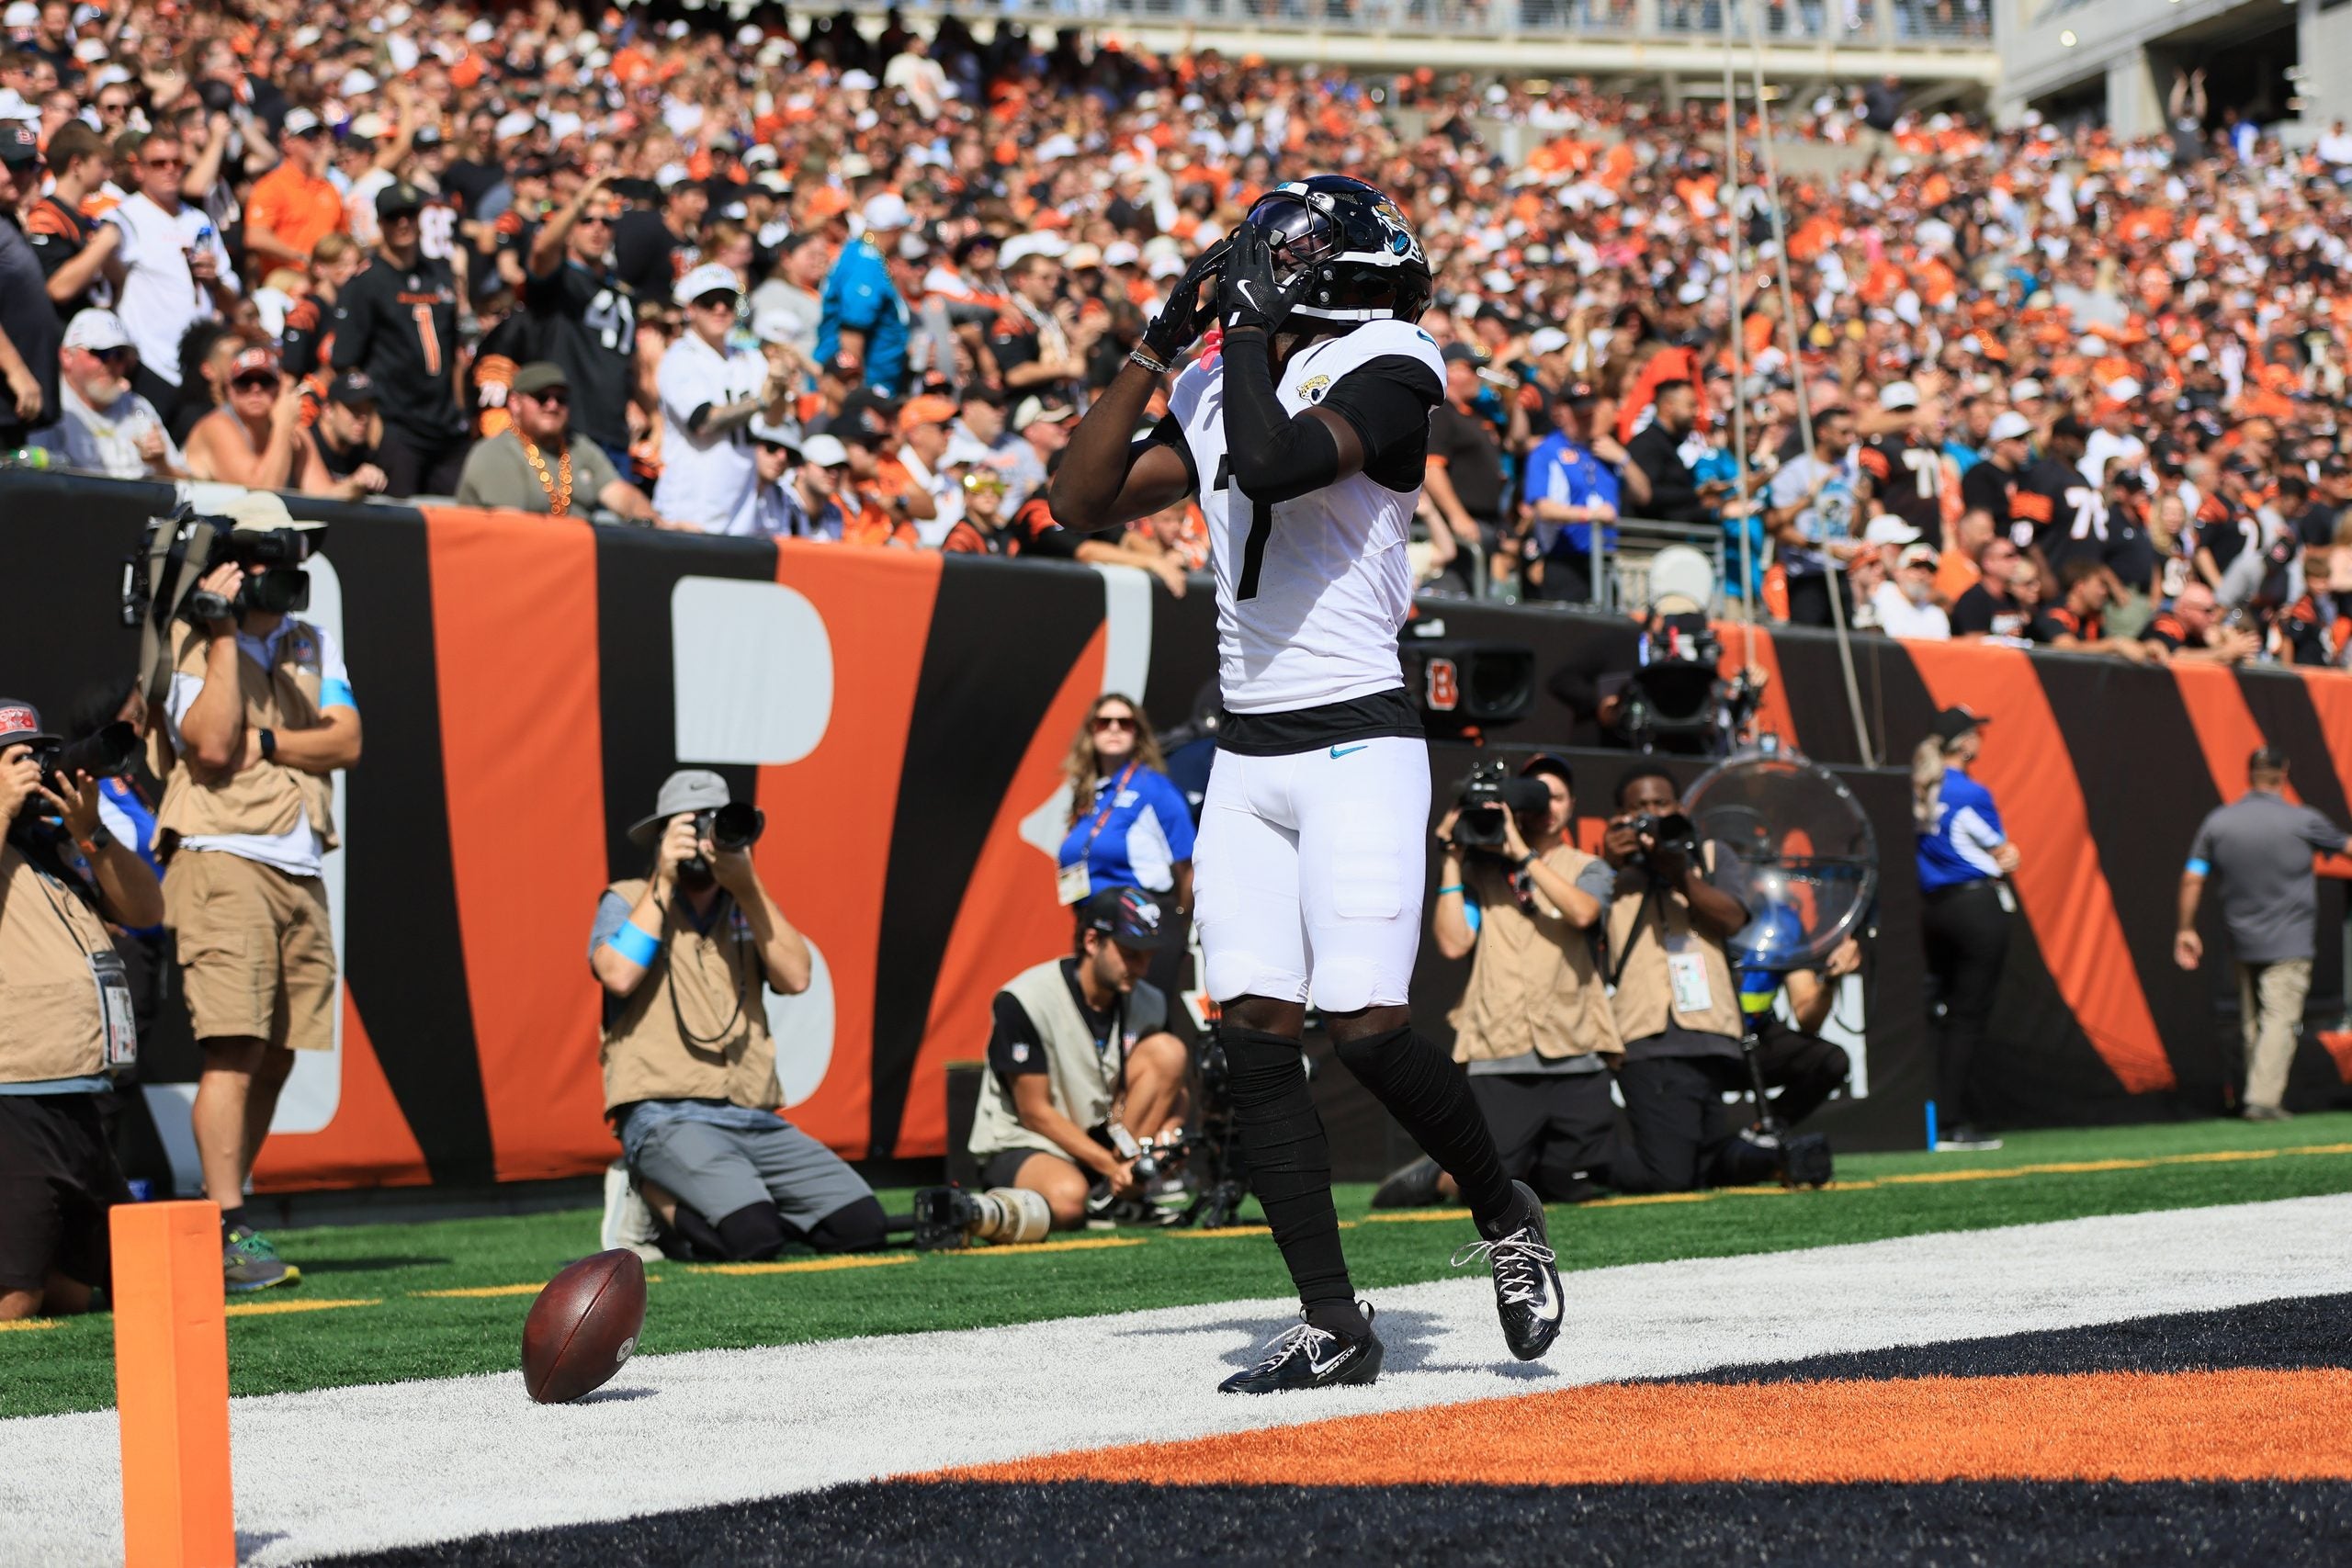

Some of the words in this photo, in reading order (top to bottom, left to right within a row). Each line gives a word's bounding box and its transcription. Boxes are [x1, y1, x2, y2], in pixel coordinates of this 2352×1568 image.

[412, 302, 442, 377] 1
[583, 288, 636, 355] 41
[1426, 658, 1459, 711] B
[1339, 1345, 1357, 1364] ZOOM
